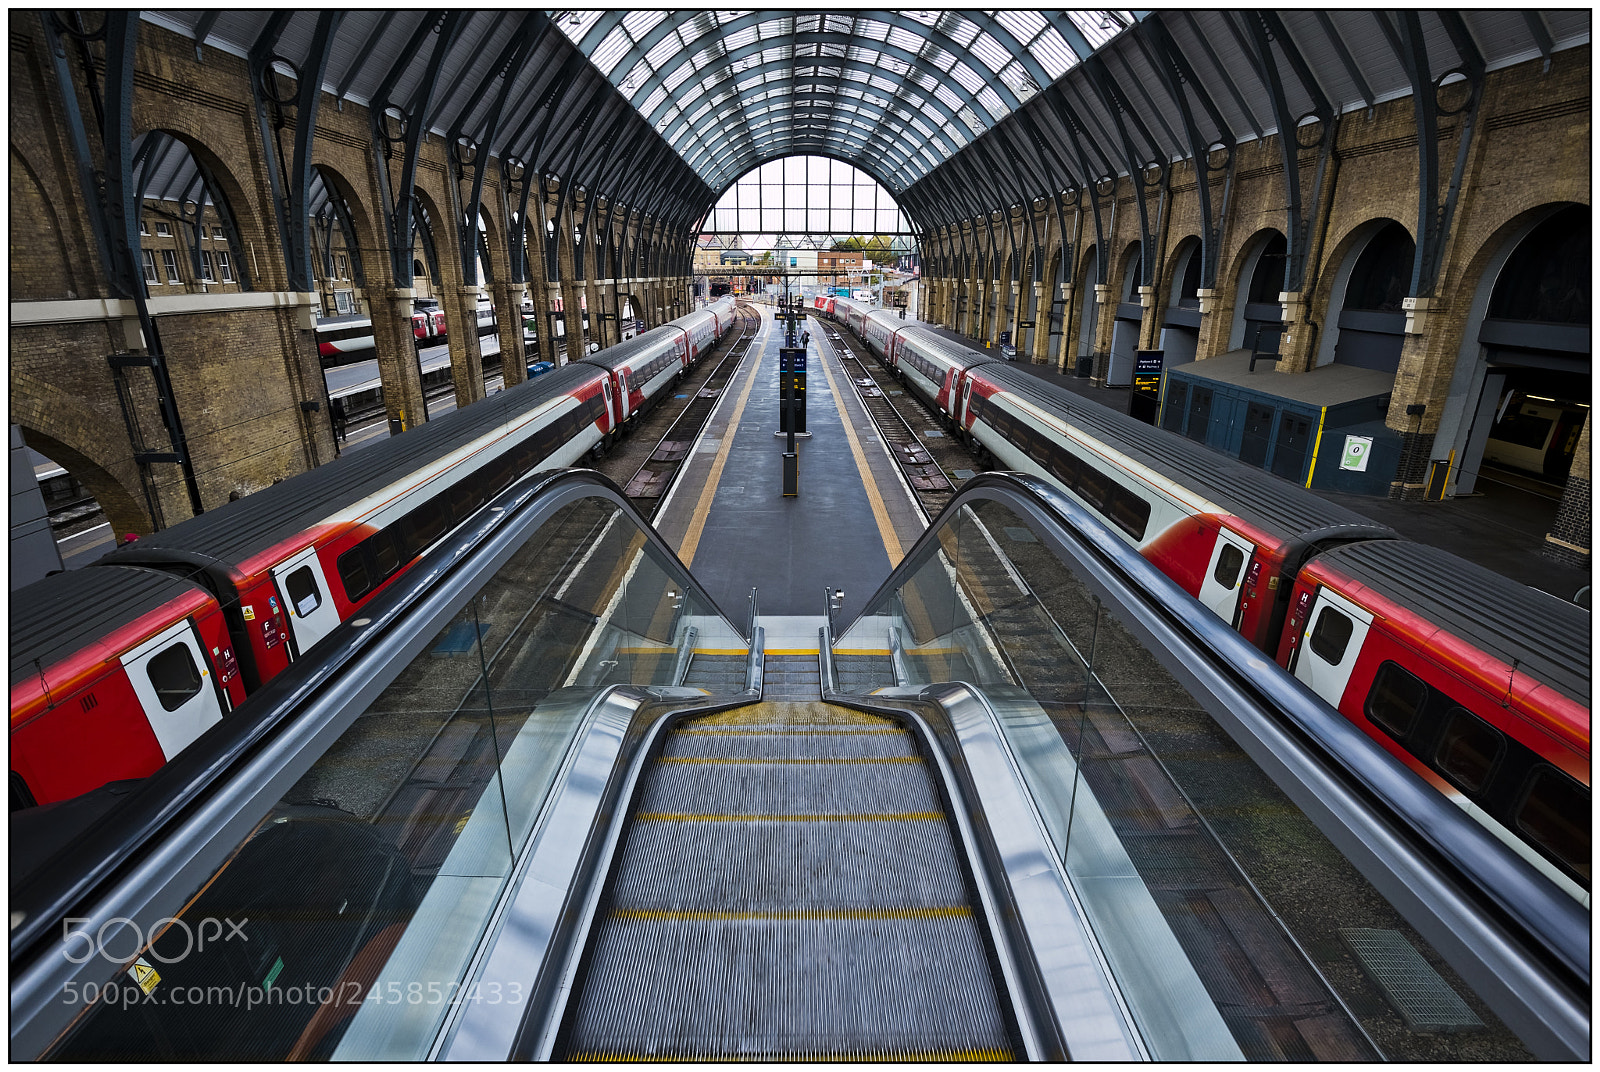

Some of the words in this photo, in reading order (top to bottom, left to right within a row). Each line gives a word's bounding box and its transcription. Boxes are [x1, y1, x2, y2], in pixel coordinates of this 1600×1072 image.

[1253, 563, 1259, 571] F
[1301, 592, 1308, 602] H
[264, 621, 270, 630] F
[224, 649, 231, 660] H
